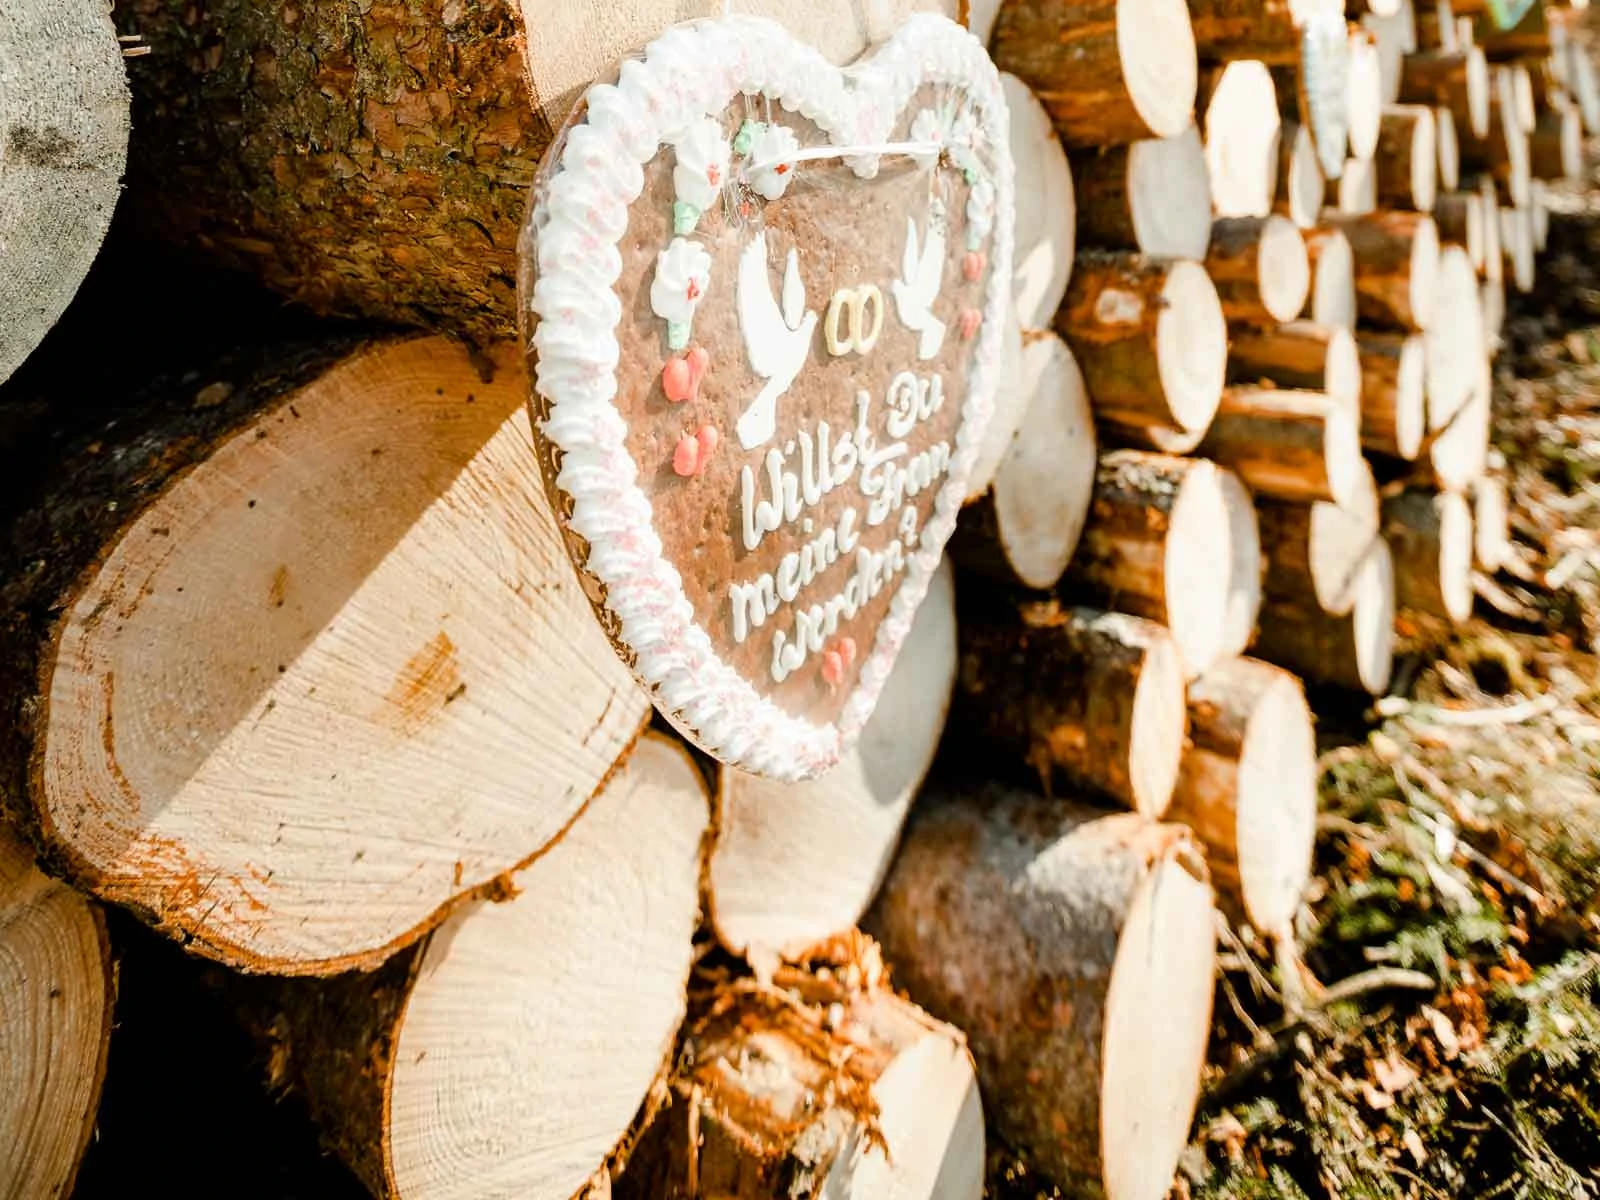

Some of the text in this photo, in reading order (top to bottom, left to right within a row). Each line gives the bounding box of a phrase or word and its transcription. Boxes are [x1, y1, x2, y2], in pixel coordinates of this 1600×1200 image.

[741, 371, 945, 551] Willst Du
[729, 506, 860, 643] meine
